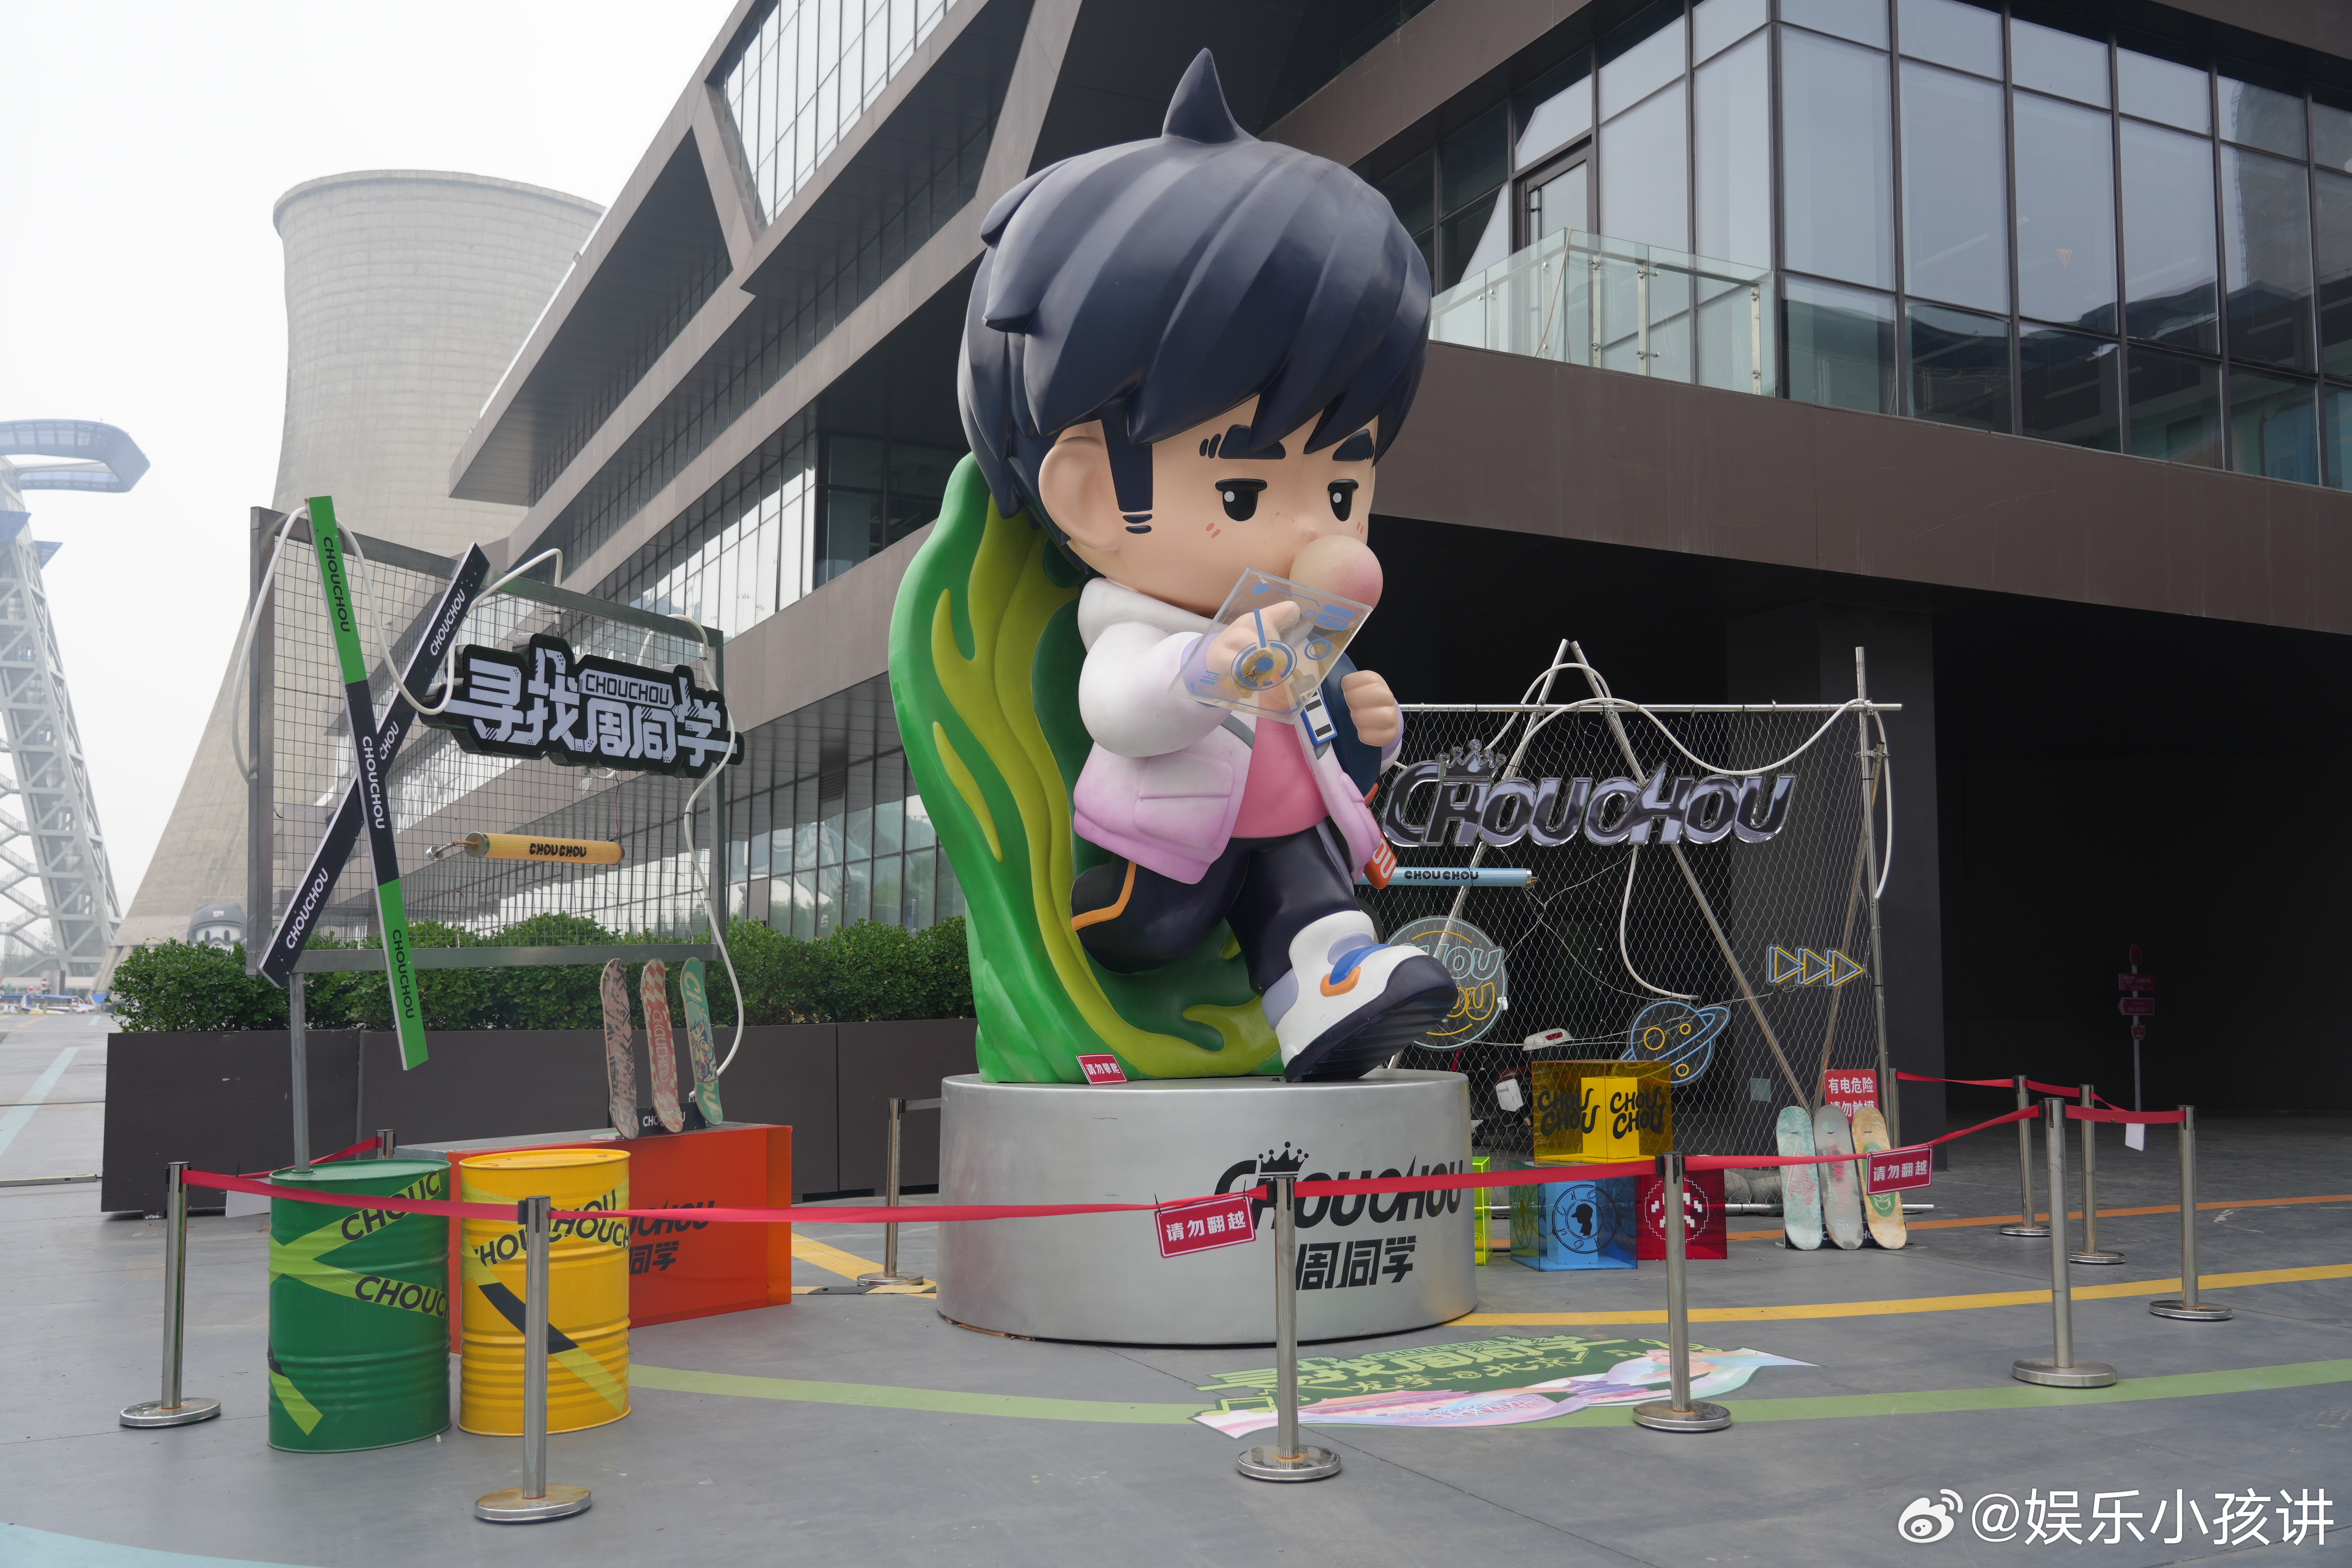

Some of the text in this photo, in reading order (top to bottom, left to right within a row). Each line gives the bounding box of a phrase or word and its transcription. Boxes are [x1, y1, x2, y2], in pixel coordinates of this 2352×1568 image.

[323, 536, 351, 632] CHOUCHOU
[430, 588, 466, 656] CHOUCHOU
[445, 647, 738, 767] 寻找周同学
[585, 673, 670, 705] CHOUCHOU
[362, 736, 385, 830] CHOUCHOU
[1382, 760, 1798, 848] CHOUCHOU
[286, 867, 330, 949] CHOUCHOU
[393, 929, 415, 1019] CHOUCHOU
[652, 1010, 672, 1083] CHOUCHOU
[1085, 1063, 1121, 1075] 请勿攀爬
[1828, 1076, 1874, 1094] 有电危险
[1537, 1088, 1595, 1112] CHOU
[1610, 1086, 1662, 1114] CHOU
[1540, 1105, 1601, 1137] CHOU
[1612, 1102, 1668, 1139] CHOU
[1873, 1160, 1927, 1183] 请勿翻越
[341, 1172, 443, 1240] CHOUC
[1166, 1211, 1247, 1242] 请勿翻越
[630, 1240, 680, 1275] 同学
[1295, 1235, 1417, 1290] 周同学
[1371, 1340, 1499, 1359] CHOUCHOU
